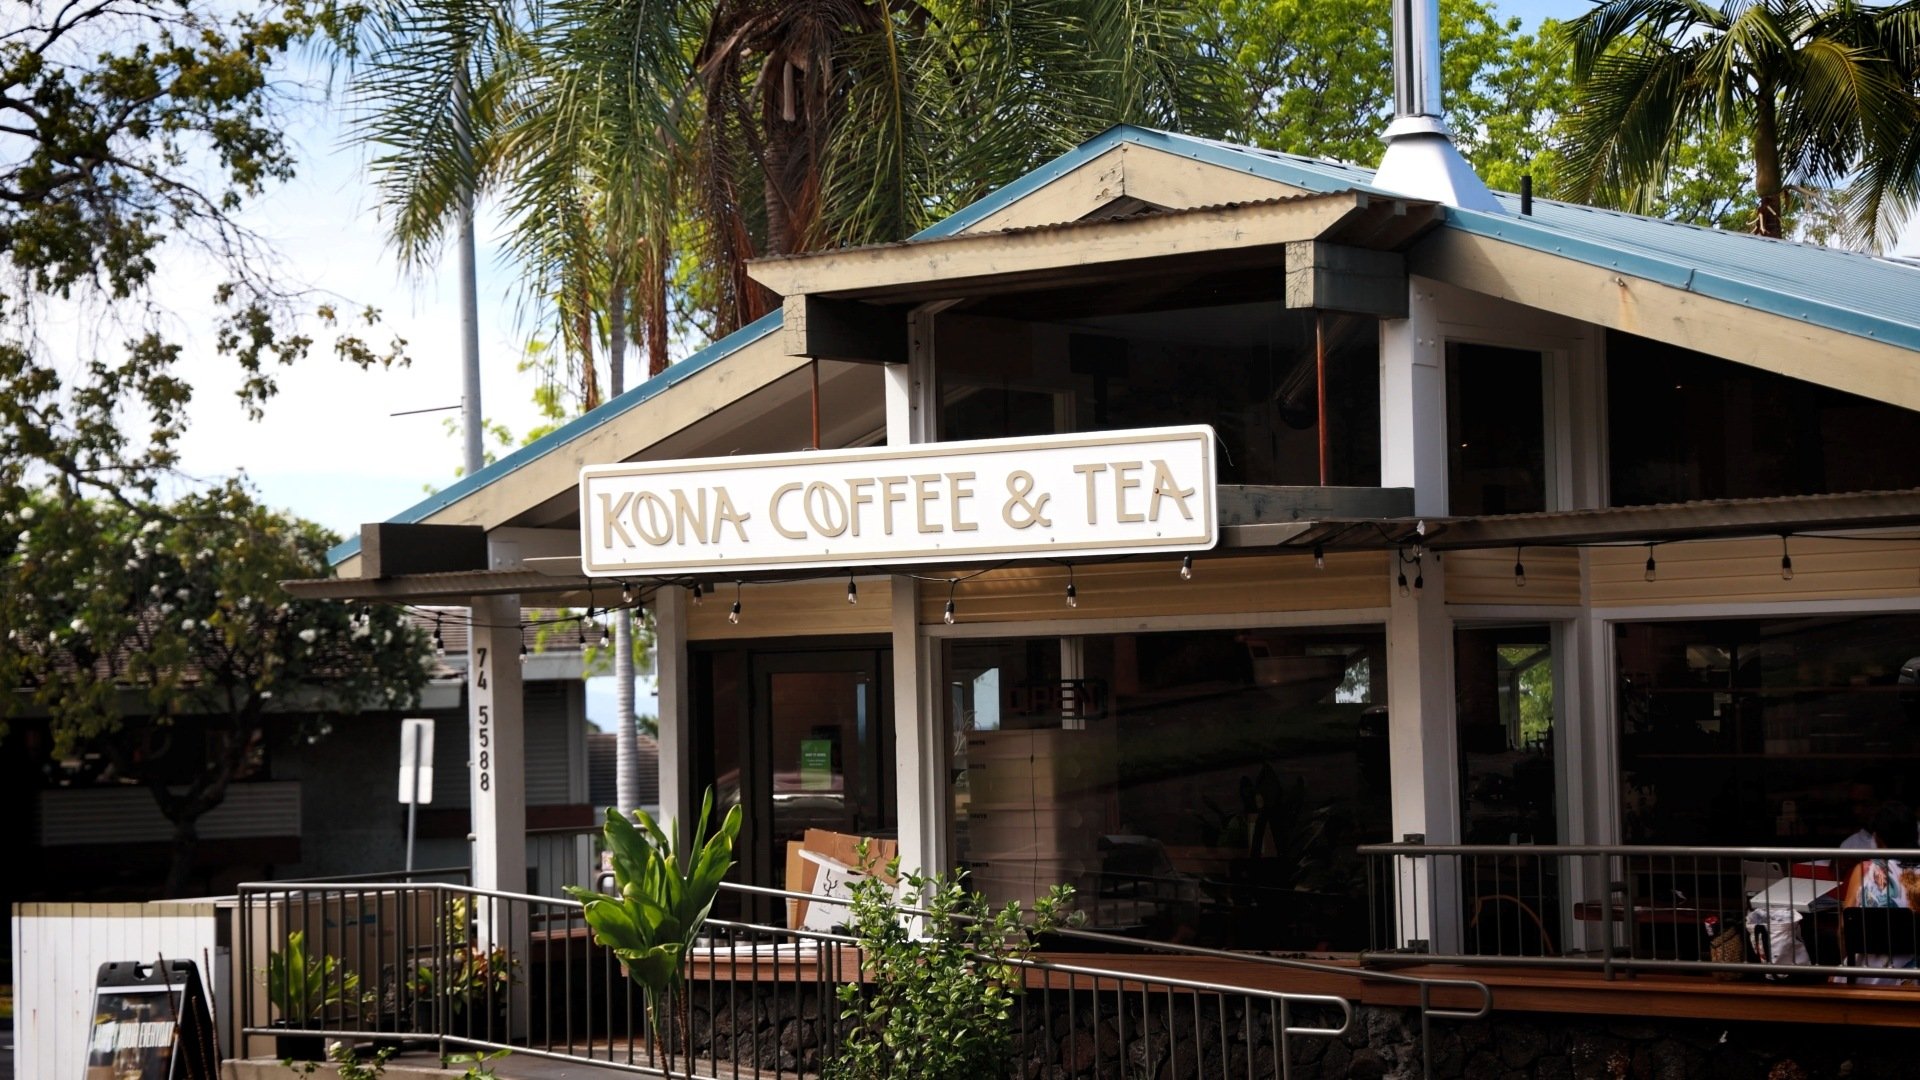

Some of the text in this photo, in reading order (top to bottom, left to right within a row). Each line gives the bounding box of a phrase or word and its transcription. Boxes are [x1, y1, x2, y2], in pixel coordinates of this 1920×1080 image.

[597, 459, 1196, 549] KONA COFFEE & TEA
[477, 648, 489, 791] 74 5588
